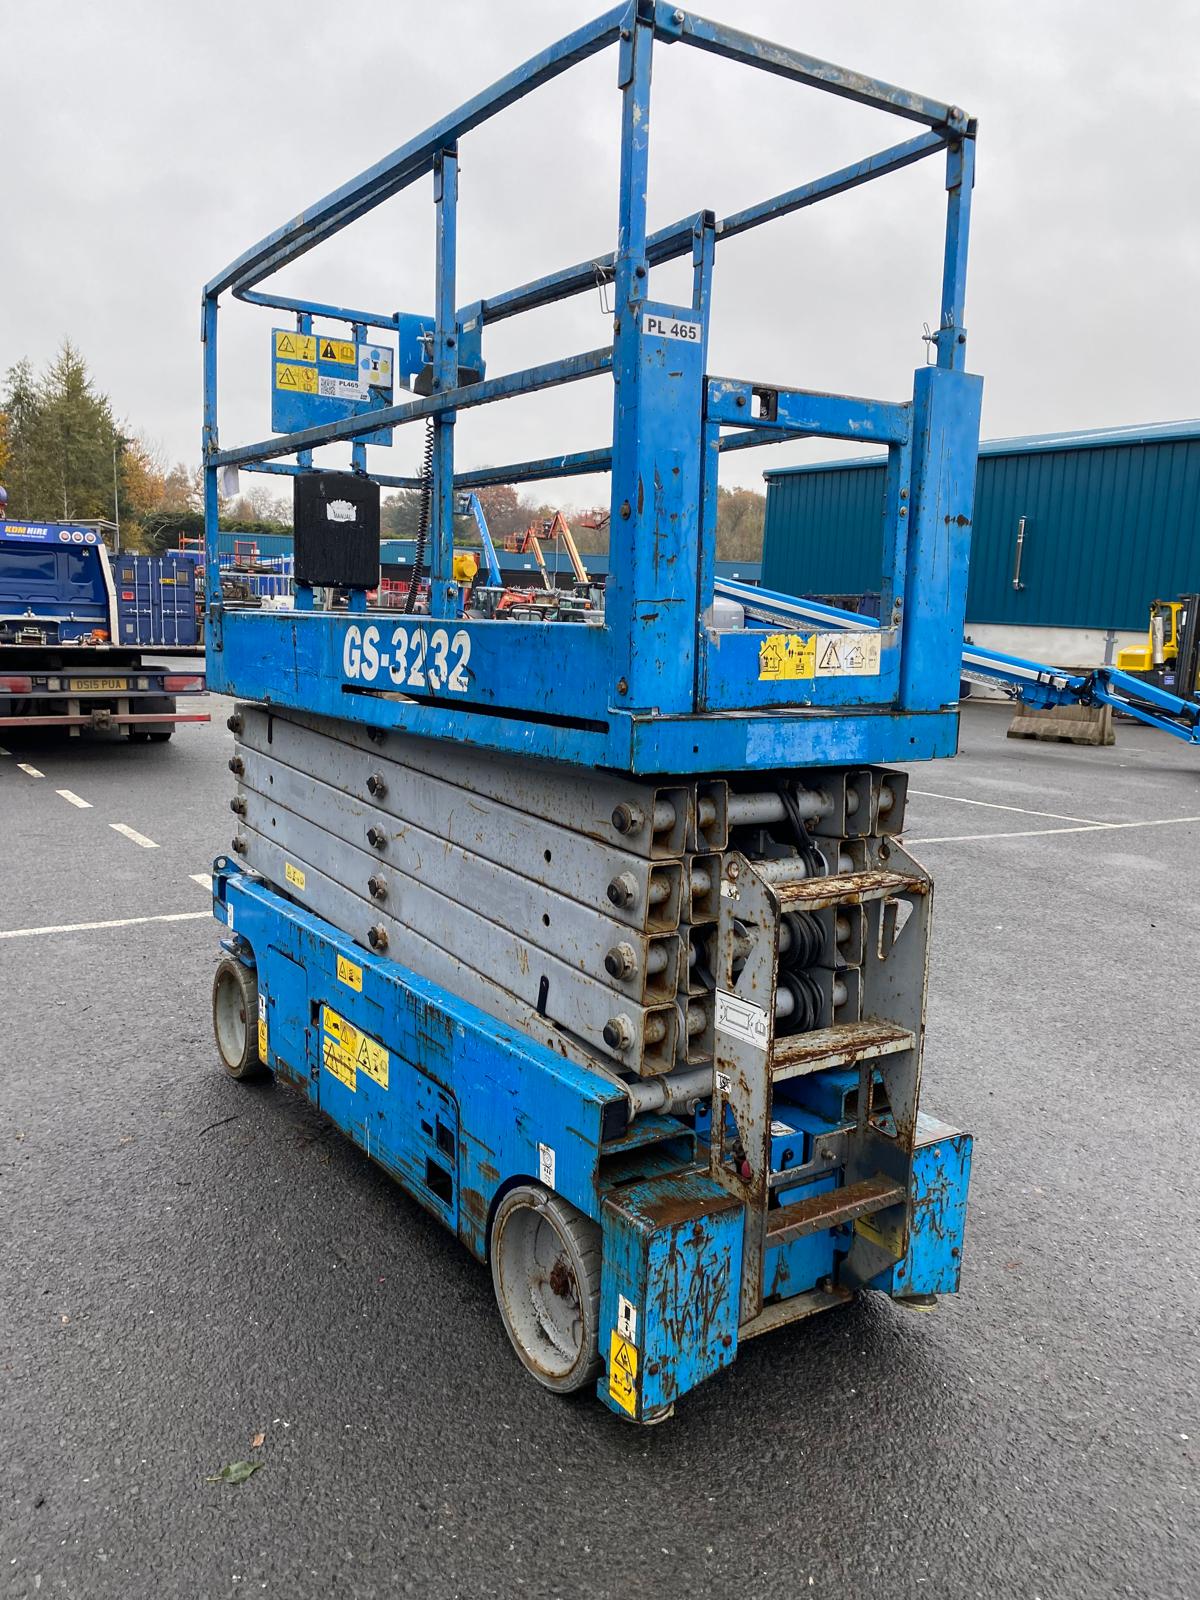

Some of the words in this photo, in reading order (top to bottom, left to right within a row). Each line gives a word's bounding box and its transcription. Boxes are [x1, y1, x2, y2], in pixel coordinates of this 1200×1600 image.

[648, 318, 666, 335] PL
[670, 323, 697, 340] 465
[338, 380, 360, 389] PL465
[27, 527, 48, 536] HIRE
[343, 624, 472, 693] GS-3232
[101, 679, 122, 689] PUA
